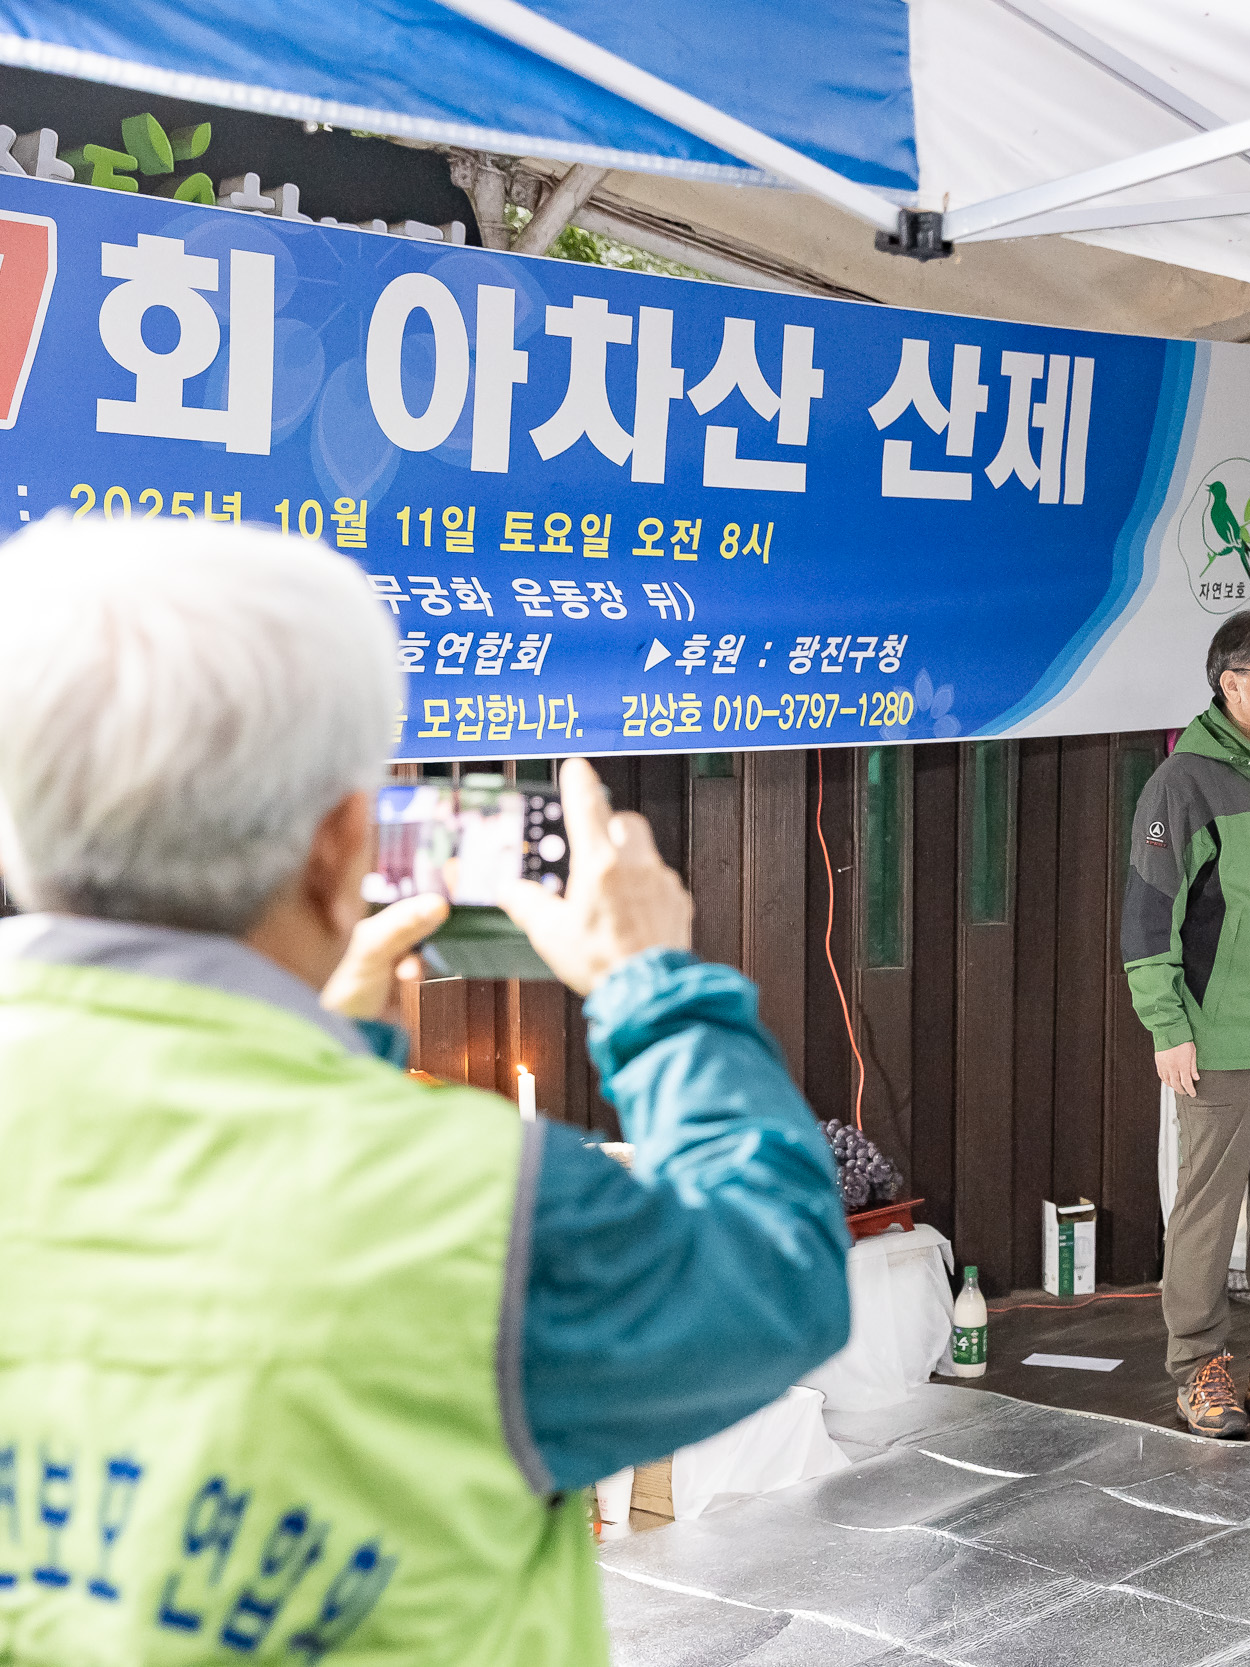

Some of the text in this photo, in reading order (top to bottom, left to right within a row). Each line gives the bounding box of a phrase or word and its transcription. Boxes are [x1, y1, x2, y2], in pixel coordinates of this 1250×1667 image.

[366, 271, 825, 492] 아차산
[868, 338, 1095, 505] 산제
[274, 496, 368, 549] 10월
[396, 505, 476, 554] 11일
[499, 510, 613, 559] 토요일
[631, 517, 703, 562] 오전
[719, 521, 775, 565] 8시
[366, 573, 696, 622] 무궁화 운동장 뒤)
[1199, 581, 1246, 600] 자연보호
[674, 633, 747, 676] 후원
[788, 633, 909, 675] 광진구청
[417, 693, 584, 742] 모집합니다.
[621, 692, 703, 738] 김상호
[712, 690, 915, 732] 010-3797-1280
